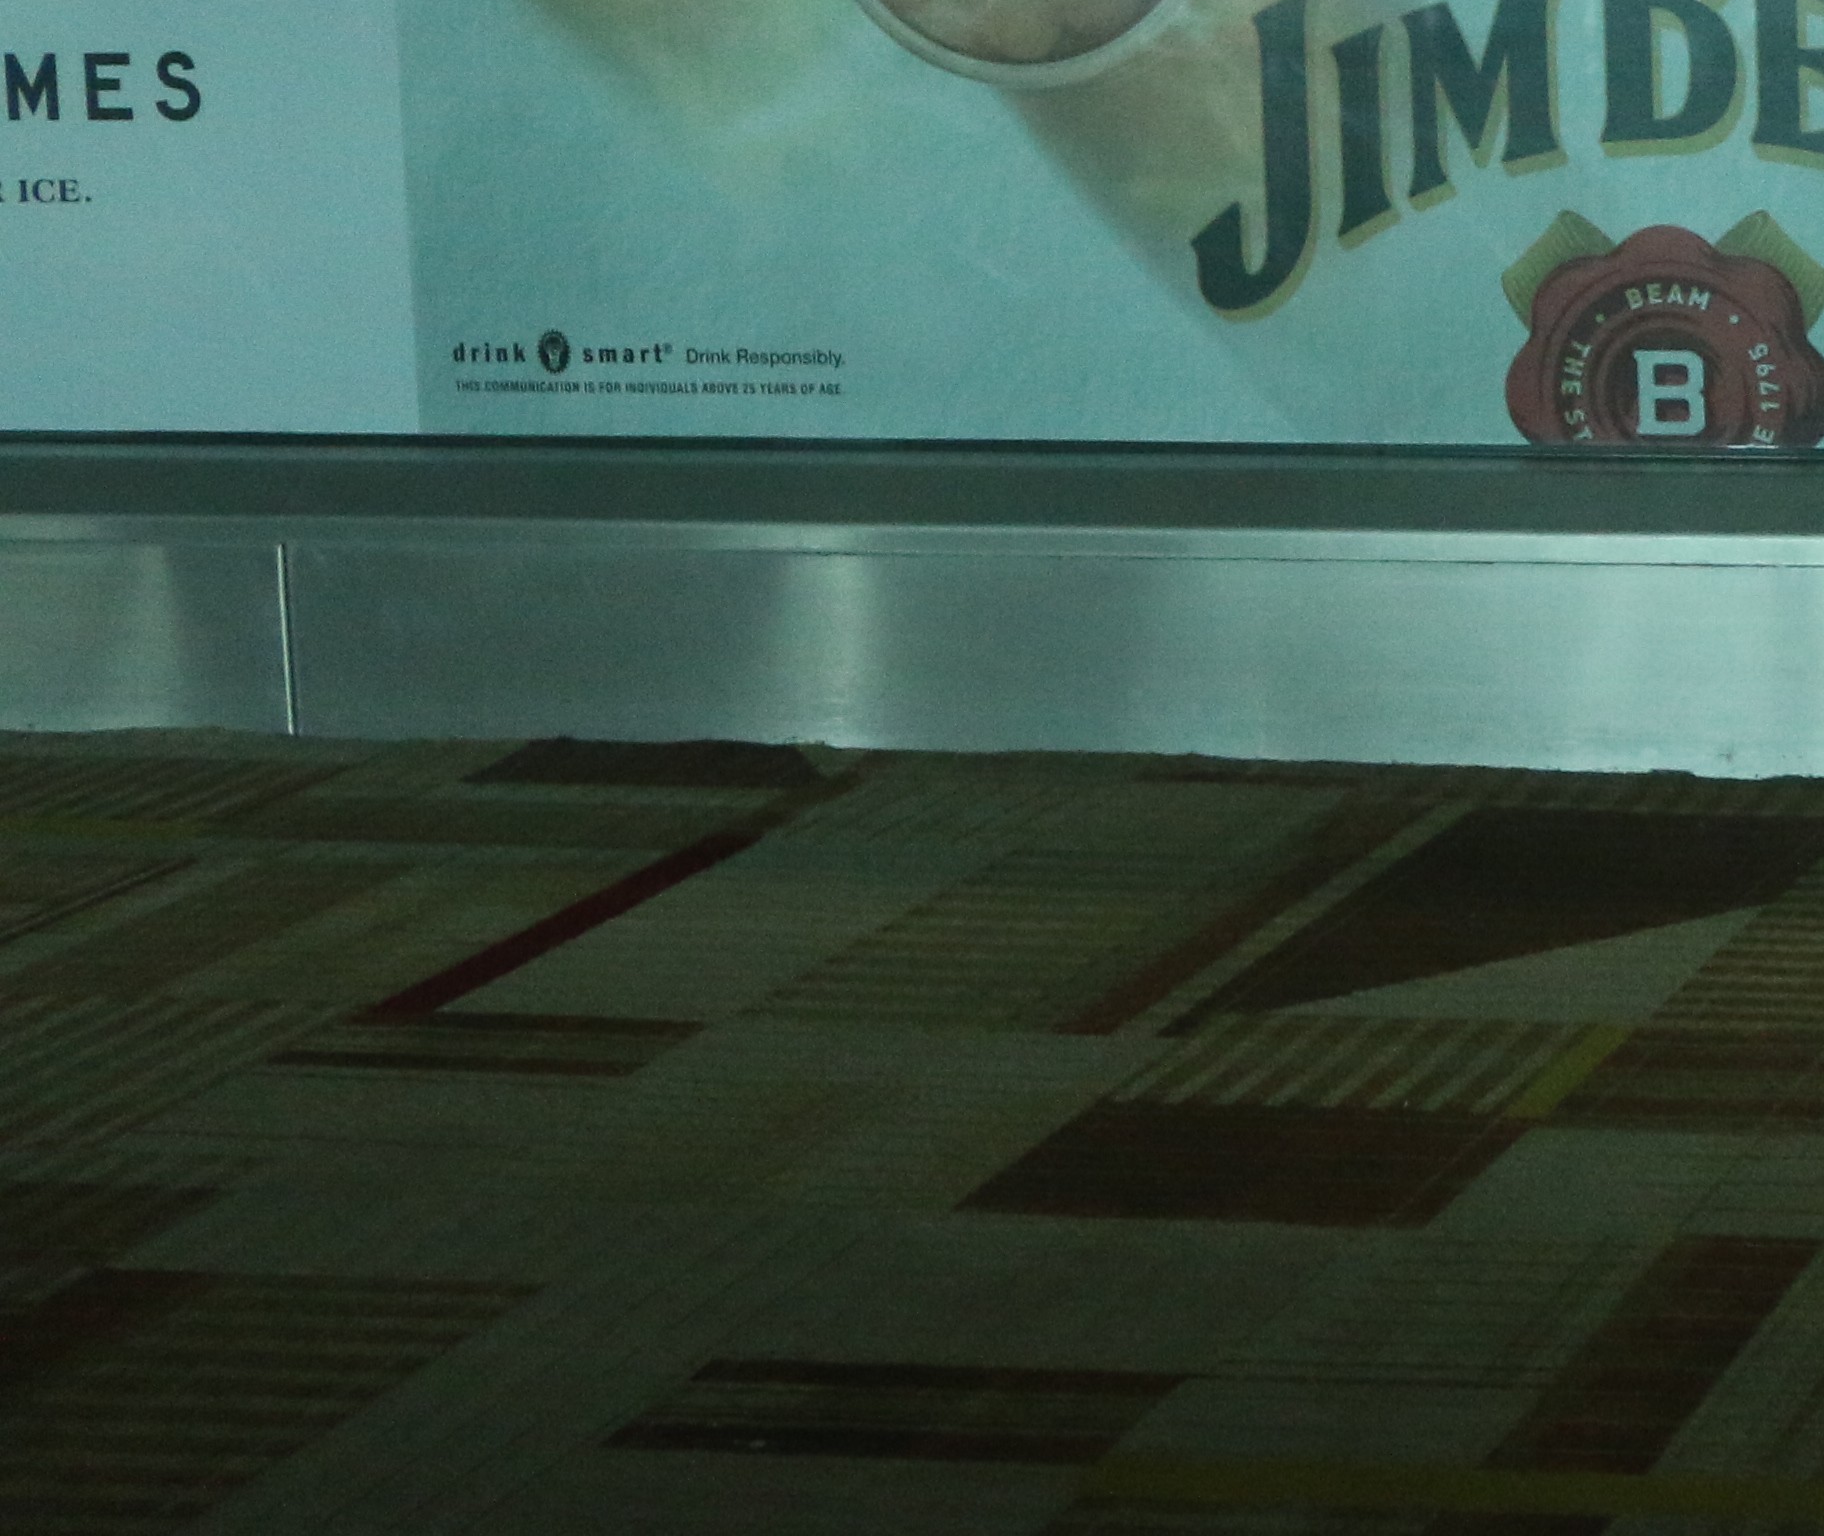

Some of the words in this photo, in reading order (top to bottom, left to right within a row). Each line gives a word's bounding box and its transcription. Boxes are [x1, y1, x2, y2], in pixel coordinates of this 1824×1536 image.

[18, 178, 92, 203] ICE.
[1624, 282, 1711, 311] BEAM
[452, 342, 526, 363] drink
[686, 348, 731, 364] Drink
[1561, 341, 1594, 396] THE
[456, 380, 481, 392] THIS
[484, 380, 580, 393] COMMUNICATION
[584, 382, 596, 394] IS
[599, 382, 621, 393] FOR
[701, 382, 739, 394] ABOVE
[1633, 349, 1707, 436] B
